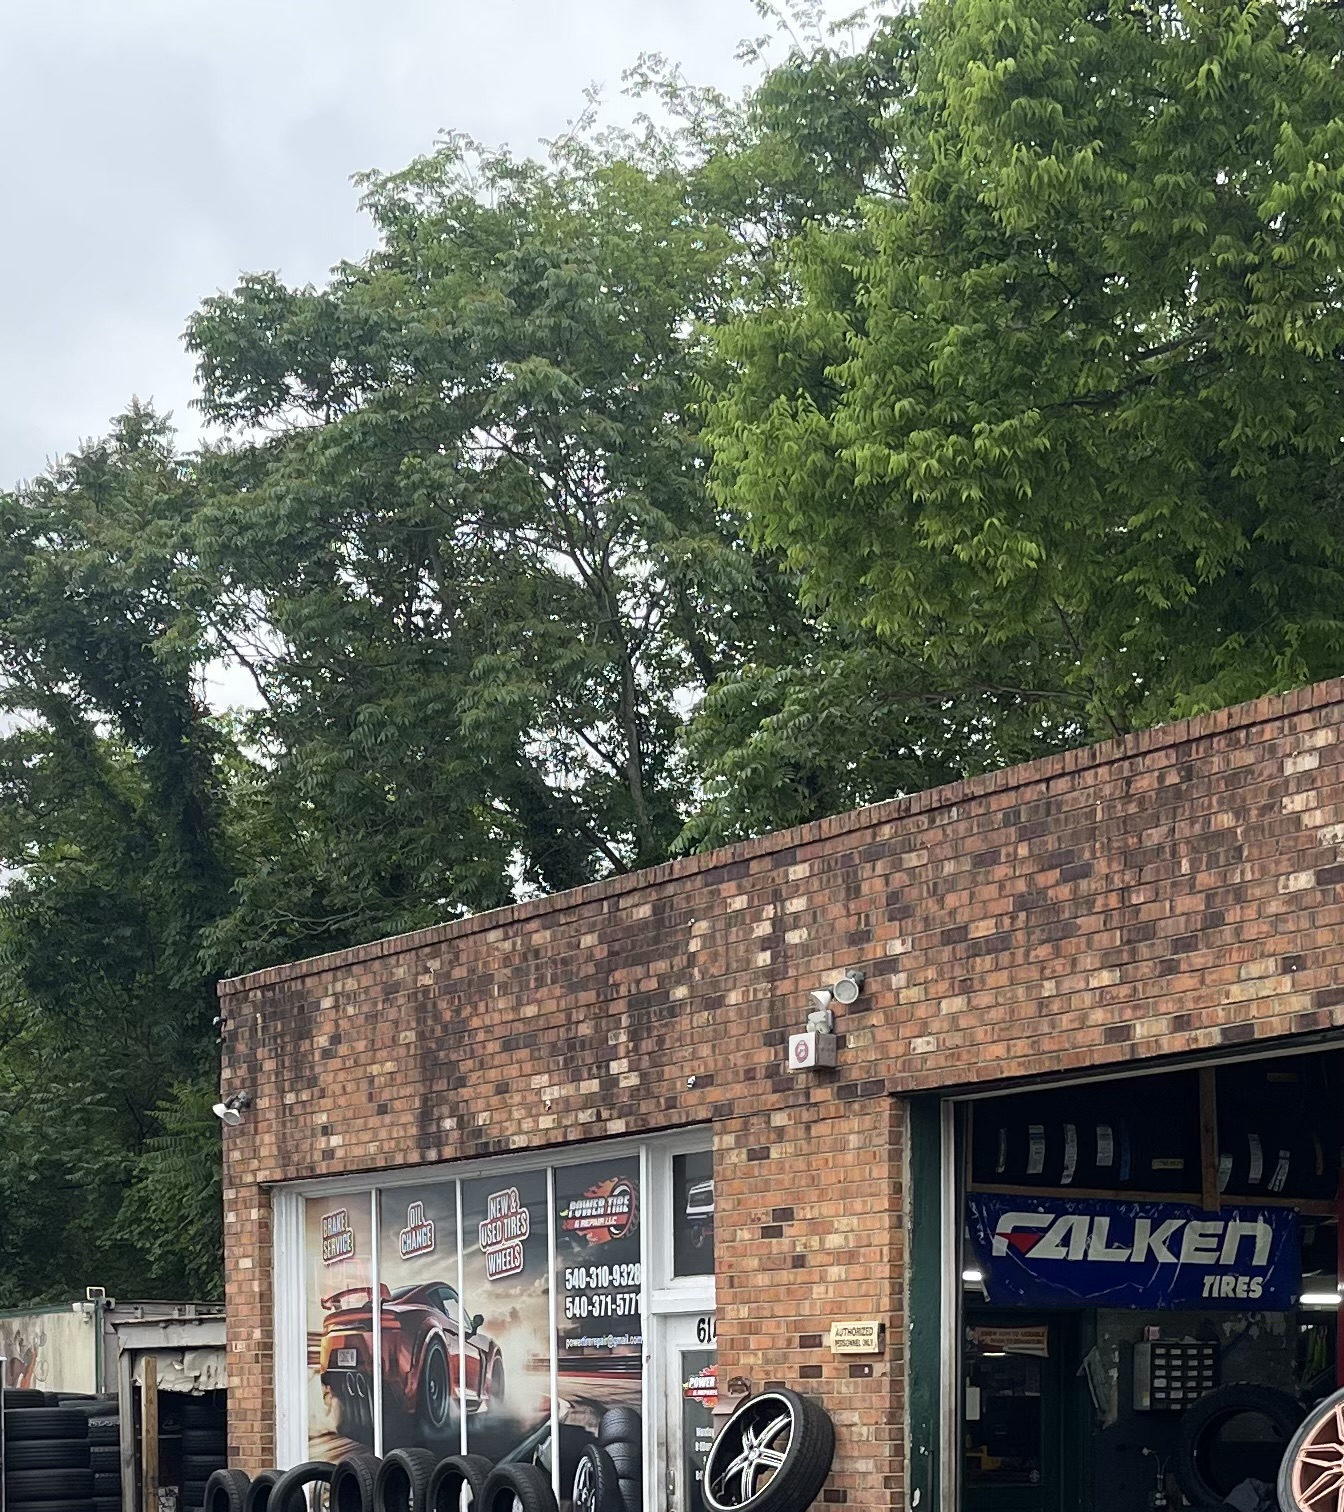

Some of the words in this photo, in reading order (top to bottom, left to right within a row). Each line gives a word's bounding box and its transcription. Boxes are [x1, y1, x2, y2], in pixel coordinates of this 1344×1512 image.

[410, 1206, 423, 1226] OIL
[490, 1195, 509, 1219] NEW
[510, 1191, 517, 1213] &
[568, 1198, 606, 1218] POWER
[606, 1195, 630, 1214] TIRE
[323, 1213, 346, 1238] BRAKE
[481, 1221, 502, 1246] USED
[503, 1212, 527, 1239] TIRES
[992, 1212, 1273, 1266] FALKEN
[323, 1232, 352, 1260] SERVICE
[401, 1226, 433, 1253] CHANGE
[488, 1245, 521, 1274] WHEELS
[565, 1263, 642, 1290] 540-310-9328
[1202, 1275, 1263, 1299] TIRES
[565, 1292, 642, 1319] 540-371-5771
[697, 1317, 717, 1344] 61
[835, 1327, 874, 1337] AUTHORIZED
[689, 1376, 715, 1388] POWER
